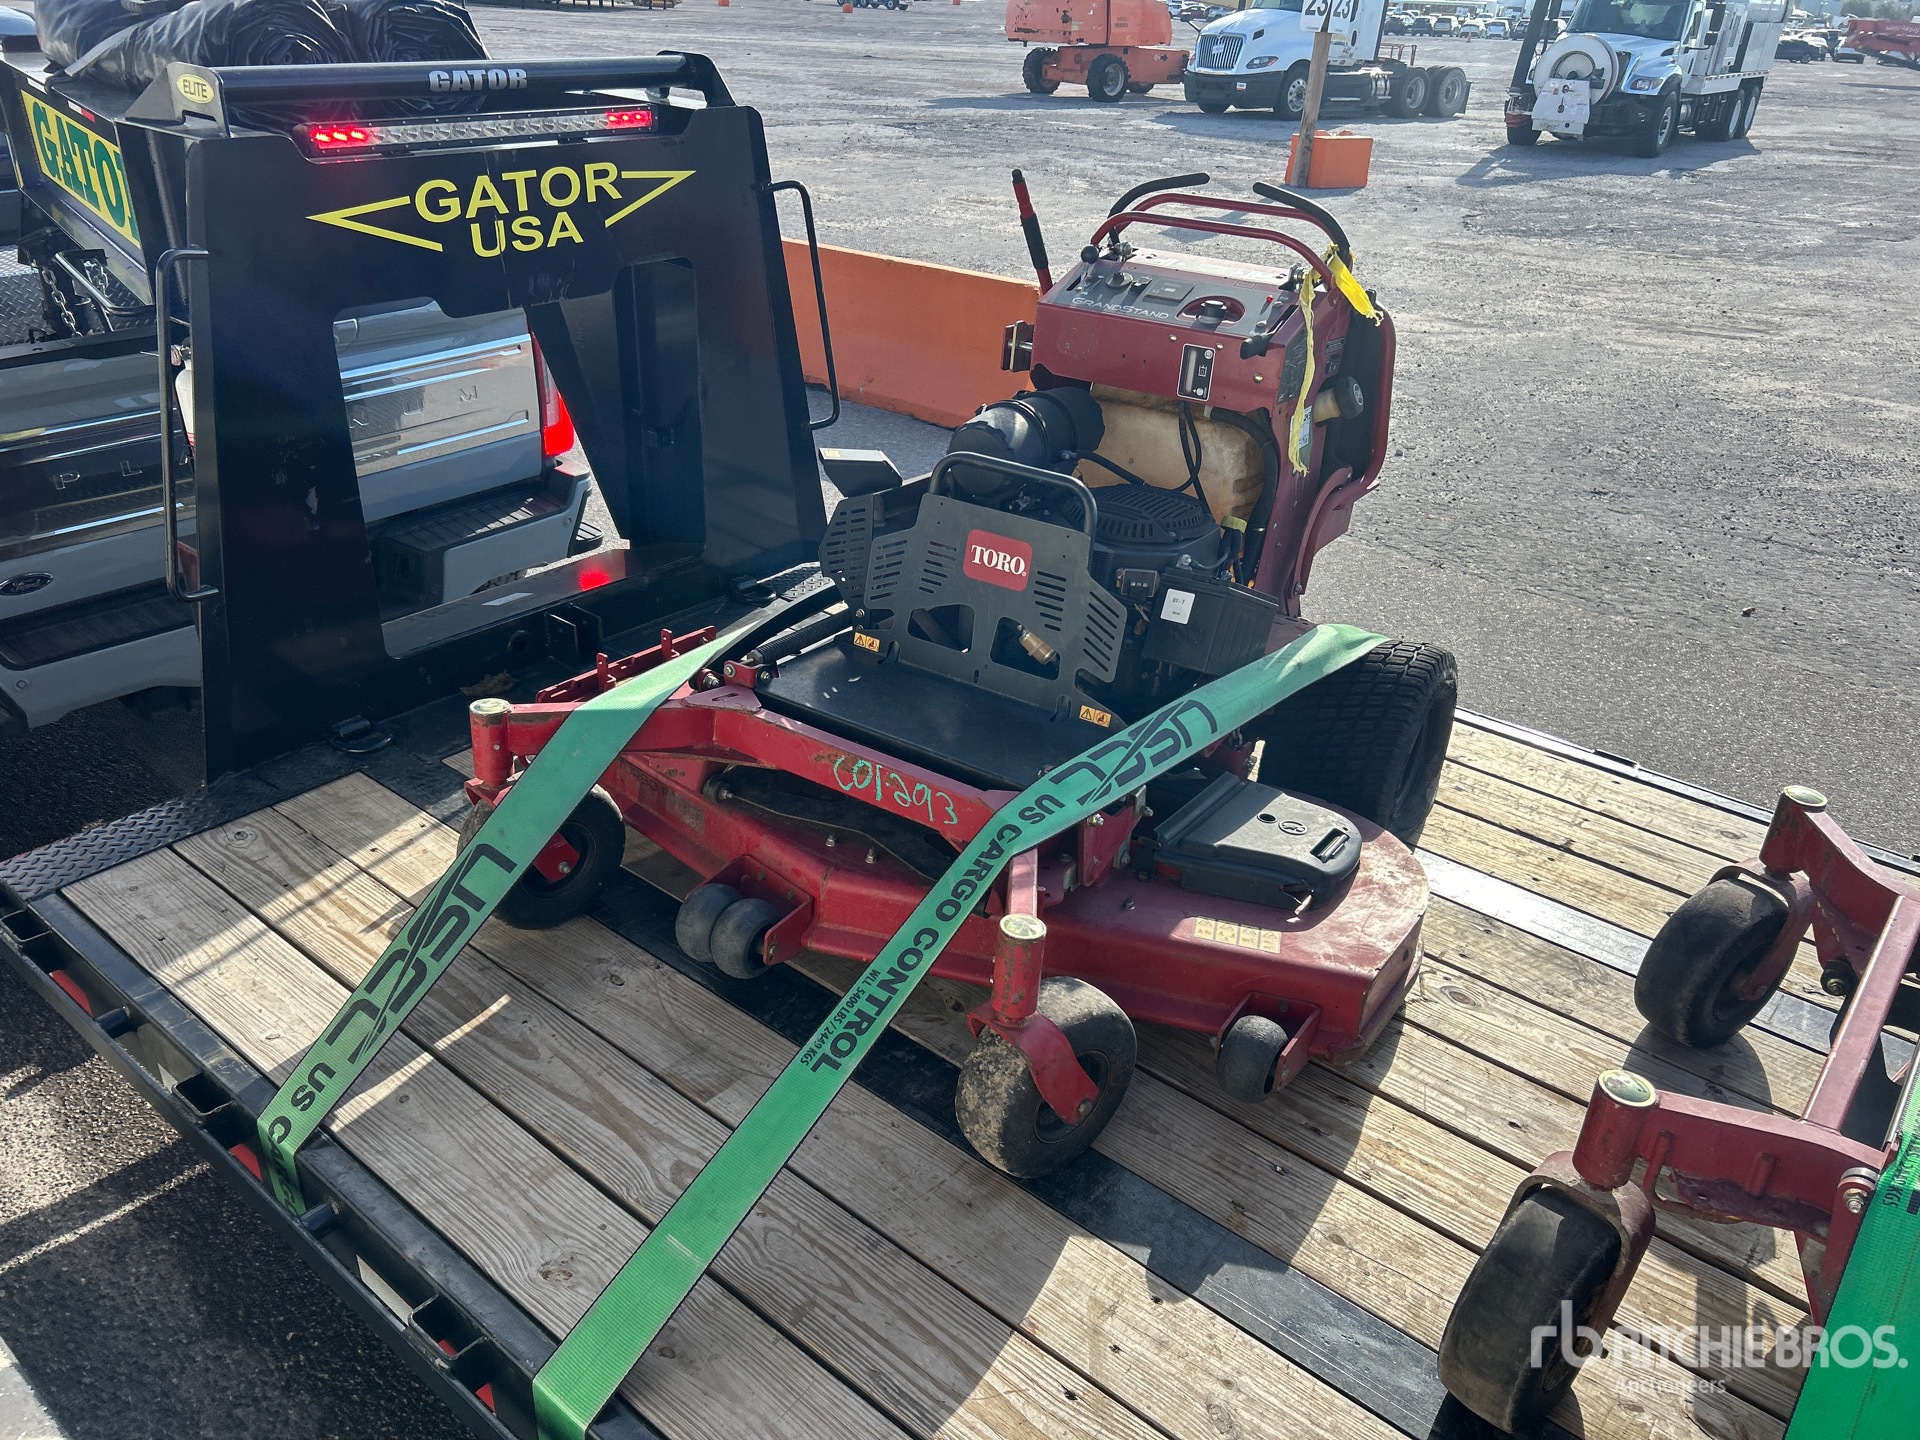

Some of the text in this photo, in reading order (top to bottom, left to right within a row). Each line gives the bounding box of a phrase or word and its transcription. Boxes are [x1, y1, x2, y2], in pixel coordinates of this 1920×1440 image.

[183, 81, 209, 99] ELITE
[429, 70, 527, 91] GATOR
[414, 162, 623, 223] GATOR
[471, 211, 585, 258] USA
[971, 544, 1026, 576] TORO
[1018, 793, 1065, 825] US
[935, 823, 1023, 922] CARGO
[862, 968, 881, 987] WLL
[810, 926, 940, 1074] CONTROL
[845, 986, 866, 1009] 5400
[833, 1006, 851, 1025] LBS
[815, 1025, 835, 1050] 2449
[800, 1046, 818, 1066] KGS
[290, 1062, 337, 1112] US
